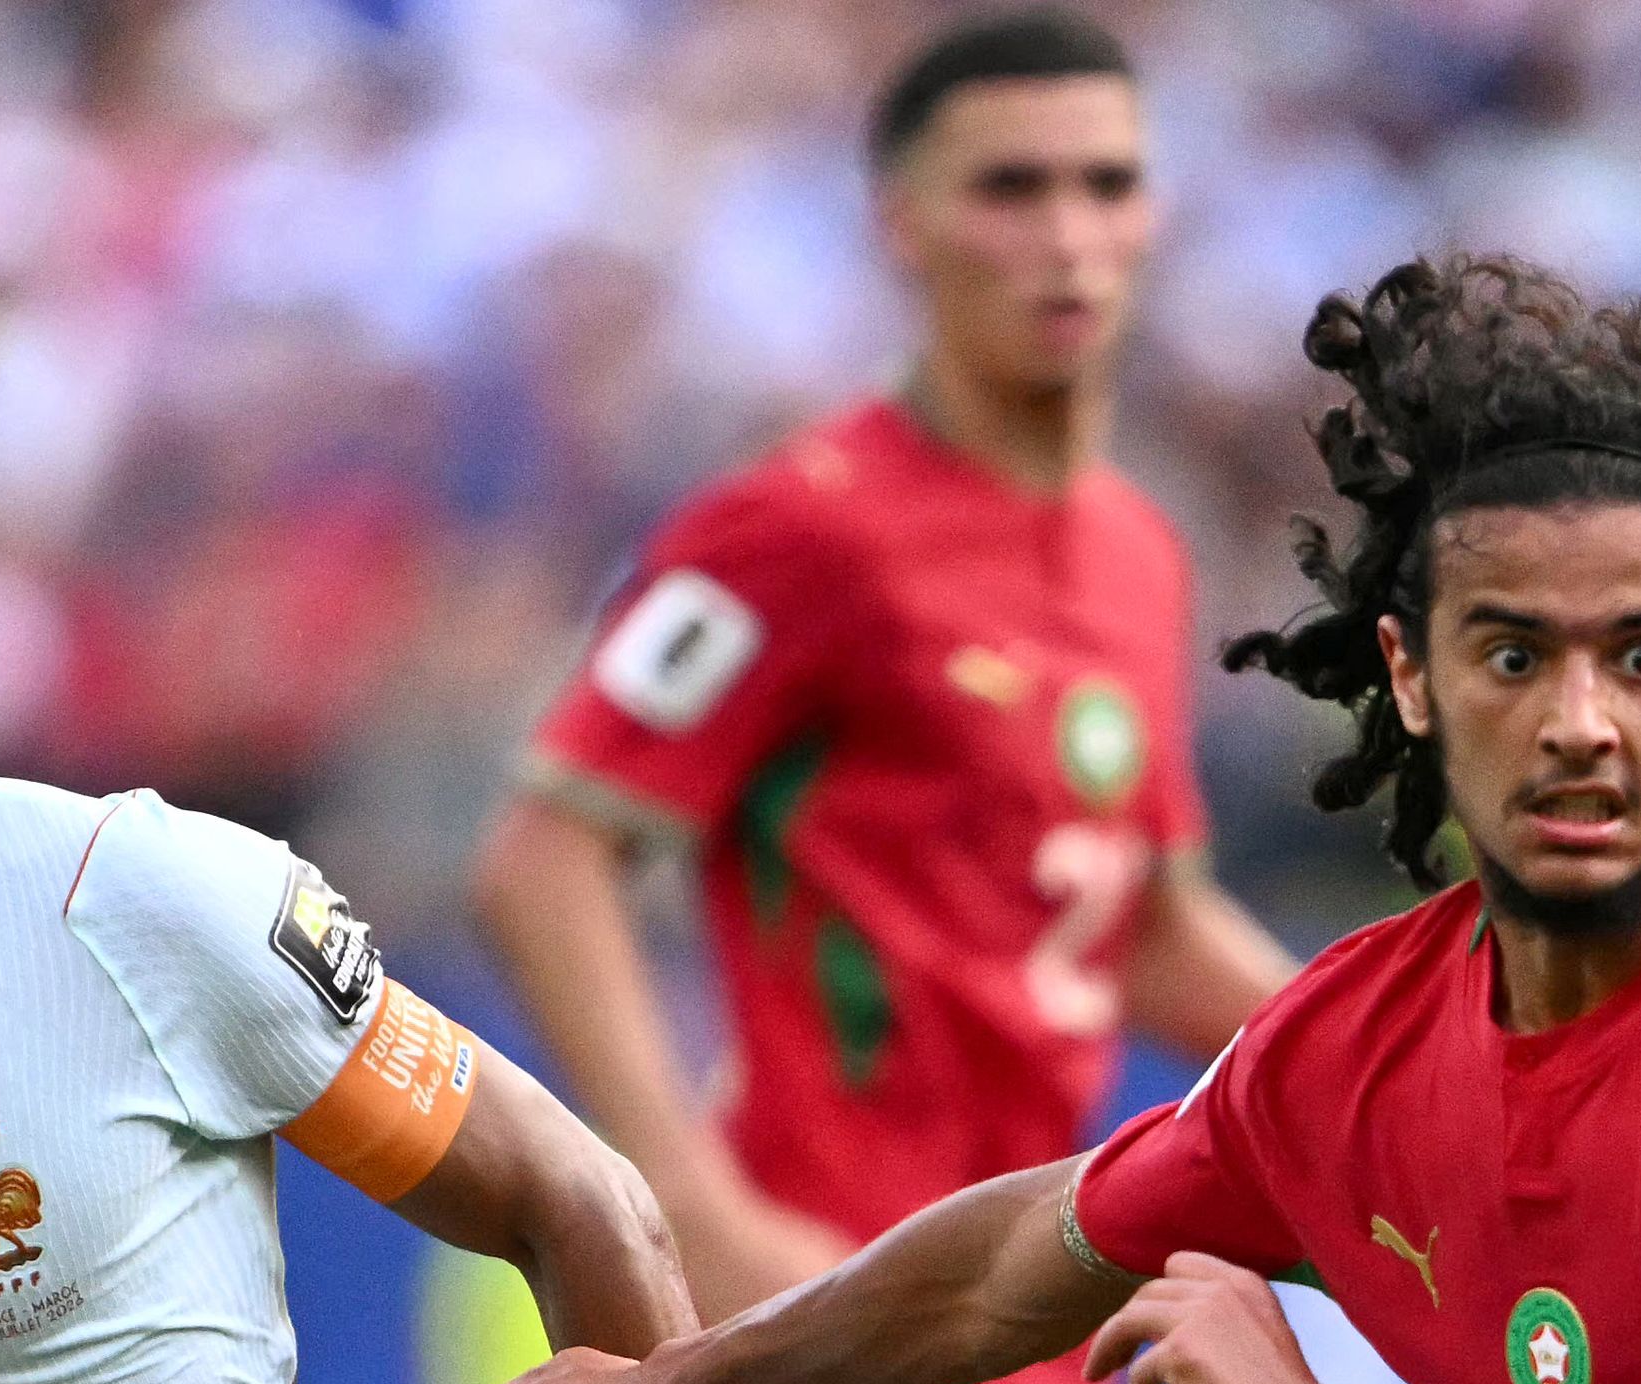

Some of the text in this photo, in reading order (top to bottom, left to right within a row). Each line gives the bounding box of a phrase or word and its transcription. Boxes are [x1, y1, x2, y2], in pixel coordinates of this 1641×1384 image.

[1027, 824, 1145, 1034] 2
[453, 1047, 469, 1088] FIFA
[31, 1281, 79, 1314] MAROC
